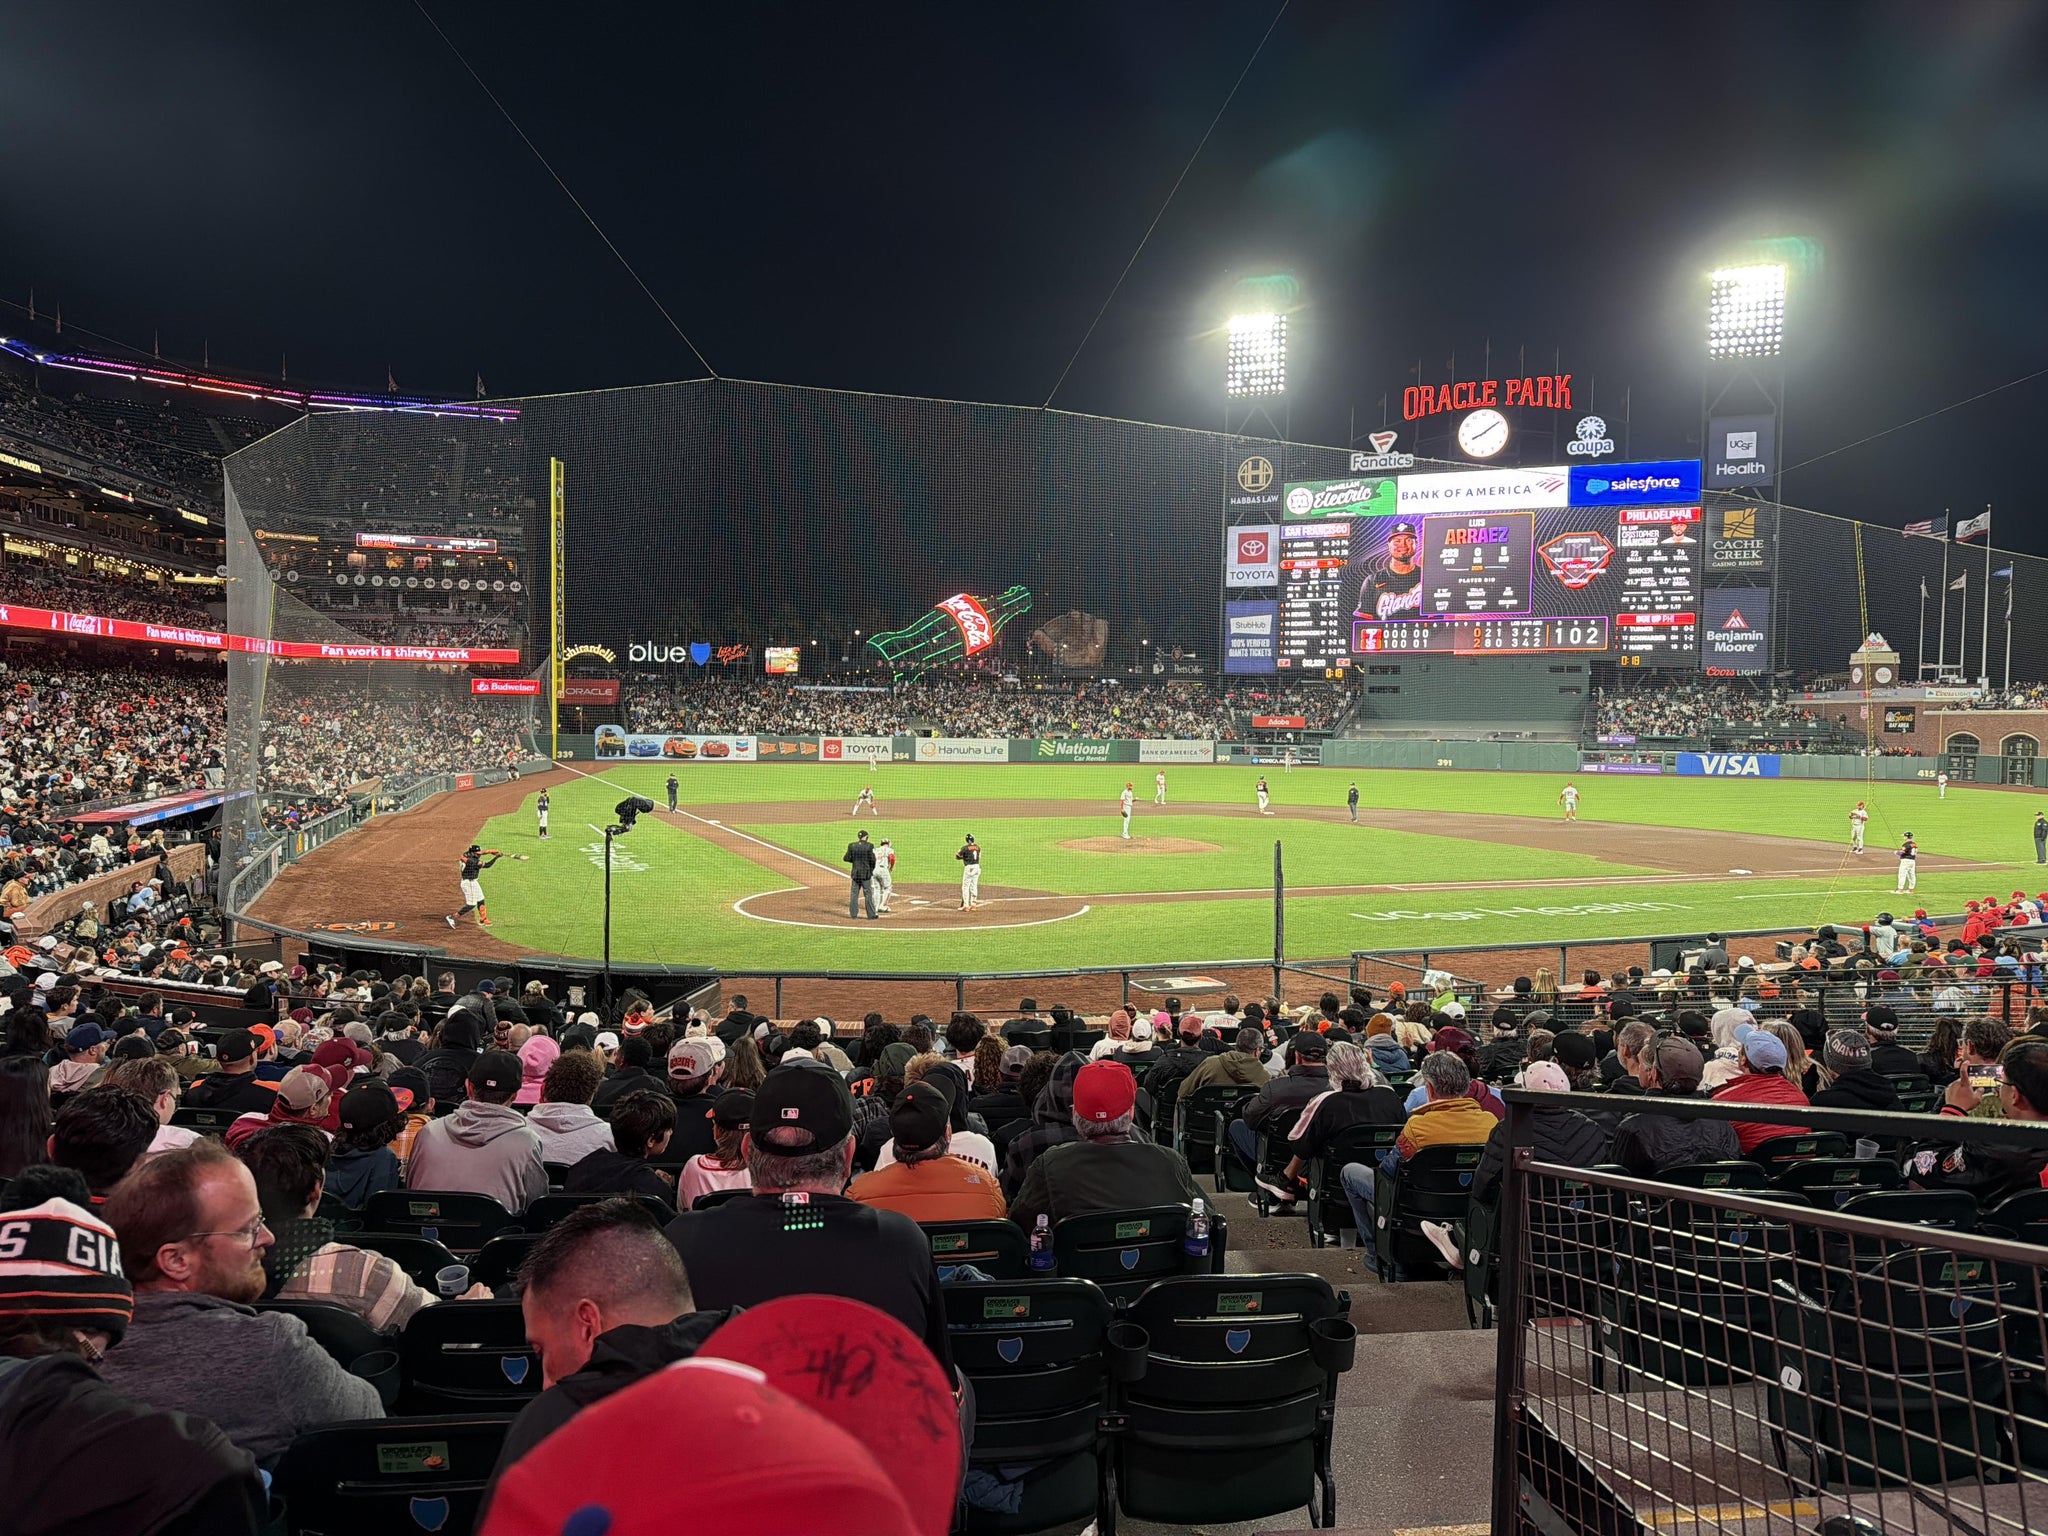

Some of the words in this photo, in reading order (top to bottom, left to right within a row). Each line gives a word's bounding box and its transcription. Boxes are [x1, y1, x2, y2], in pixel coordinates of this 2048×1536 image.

[1402, 380, 1498, 421] ORACLE
[1505, 374, 1573, 410] PARK
[1569, 439, 1613, 456] coupa
[1729, 439, 1754, 451] UCSF
[1353, 452, 1412, 470] Fanatics
[1716, 461, 1766, 476] Health
[1611, 476, 1681, 492] salesforce
[1313, 486, 1372, 508] Electric
[1401, 489, 1440, 501] BANK
[1444, 488, 1462, 498] OF
[1464, 485, 1532, 497] AMERICA
[1230, 496, 1261, 505] HABBAS
[1262, 495, 1279, 503] LAW
[1626, 510, 1692, 521] PHILADELPHIA
[1468, 519, 1485, 527] LUIS
[1285, 527, 1301, 537] SAN
[1444, 526, 1509, 544] ARRAEZ
[1622, 530, 1659, 538] CRISTOPHER
[1622, 537, 1658, 546] SÁNCHEZ
[1712, 539, 1764, 550] CACHE
[1714, 549, 1762, 560] CREEK
[1229, 570, 1275, 580] TOYOTA
[1235, 621, 1266, 630] StubHub
[146, 626, 160, 637] Fan
[160, 628, 177, 639] work
[178, 630, 184, 640] is
[185, 631, 206, 645] thirsty
[206, 635, 221, 645] work
[1383, 630, 1389, 638] 0
[1392, 629, 1398, 638] 0
[1401, 629, 1407, 638] 0
[1413, 629, 1420, 638] 0
[1423, 629, 1428, 638] 0
[1474, 628, 1481, 637] 0
[1485, 628, 1491, 637] 2
[1497, 628, 1501, 636] 1
[1512, 628, 1518, 636] 3
[1522, 628, 1529, 636] 4
[1534, 628, 1540, 636] 2
[1555, 628, 1562, 644] 1
[1570, 628, 1581, 644] 0
[1586, 627, 1598, 644] 2
[1706, 631, 1764, 643] Benjamin
[1231, 639, 1246, 648] 100%
[1246, 638, 1270, 647] VERIFIED
[1384, 640, 1388, 648] 1
[1392, 640, 1398, 648] 0
[1401, 640, 1407, 648] 0
[1413, 640, 1419, 648] 0
[1423, 639, 1427, 648] 1
[1474, 639, 1481, 648] 2
[1485, 639, 1491, 647] 8
[1496, 639, 1502, 647] 0
[1512, 638, 1518, 647] 3
[1522, 638, 1529, 647] 4
[1534, 638, 1540, 647] 2
[321, 646, 344, 657] Fan
[346, 647, 378, 657] work
[381, 647, 392, 657] is
[394, 647, 435, 660] thirsty
[438, 648, 469, 659] work
[562, 644, 617, 663] Ghirardelli
[629, 640, 687, 663] blue
[1229, 648, 1248, 657] GIANTS
[1249, 648, 1271, 657] TICKETS
[1706, 665, 1735, 677] Coors
[1736, 669, 1762, 677] LIGHT
[490, 682, 536, 691] Budweiser
[565, 687, 613, 697] ORACLE
[1268, 718, 1290, 726] Adobe
[846, 744, 889, 754] TOYOTA
[938, 745, 981, 756] Hanwha
[984, 745, 1004, 755] Life
[1056, 742, 1110, 755] National
[557, 751, 574, 759] 339
[894, 752, 910, 760] 354
[1437, 759, 1452, 767] 391
[1696, 755, 1760, 776] VISA
[1918, 770, 1936, 778] 415
[1349, 910, 1486, 921] UCSF
[1475, 901, 1694, 918] Health
[1831, 1038, 1868, 1057] GIANTS
[1786, 1371, 1793, 1386] L
